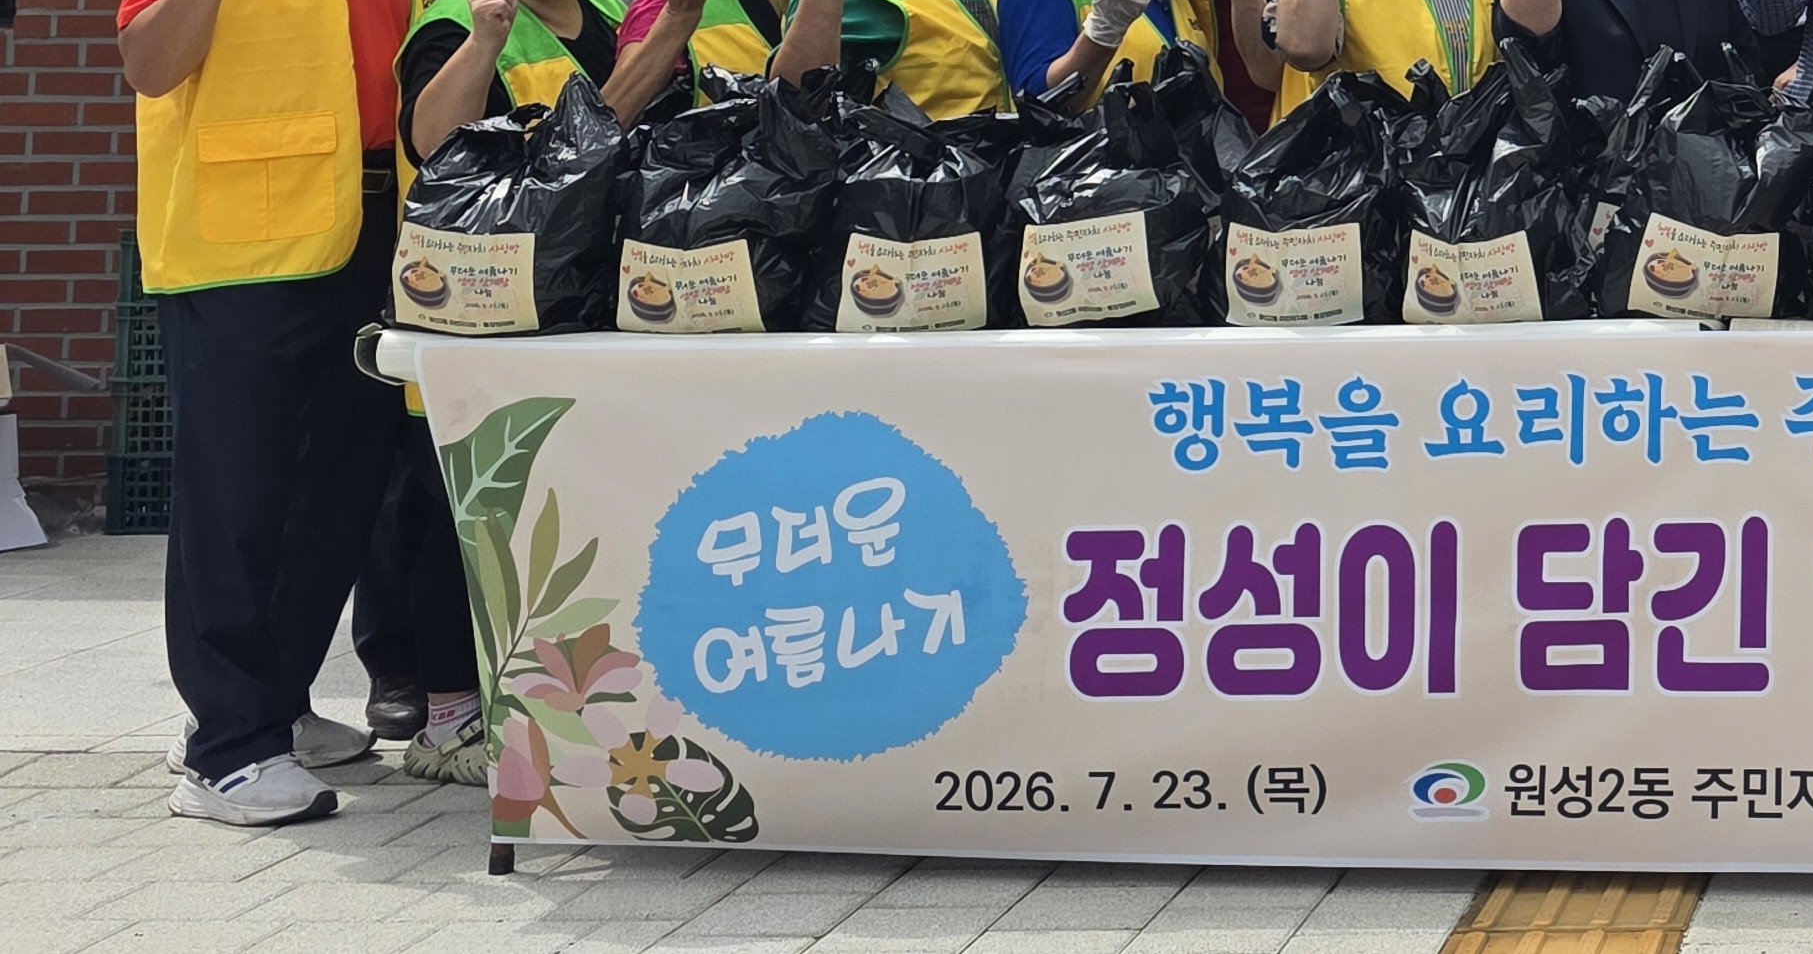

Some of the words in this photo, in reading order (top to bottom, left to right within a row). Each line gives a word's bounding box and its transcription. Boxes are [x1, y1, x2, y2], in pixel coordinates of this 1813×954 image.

[1729, 263, 1764, 272] 여름나기
[1148, 376, 1400, 471] 행복을
[1424, 372, 1759, 466] 요리하는
[697, 476, 905, 586] 무더운
[693, 587, 966, 693] 여름나기
[1063, 520, 1458, 698] 정성이
[1516, 516, 1770, 693] 담긴
[933, 771, 1070, 813] 2026.
[1088, 772, 1133, 812] 7.
[1152, 771, 1227, 811] 23.
[1246, 764, 1328, 815] (목)
[1504, 763, 1673, 820] 원성2동
